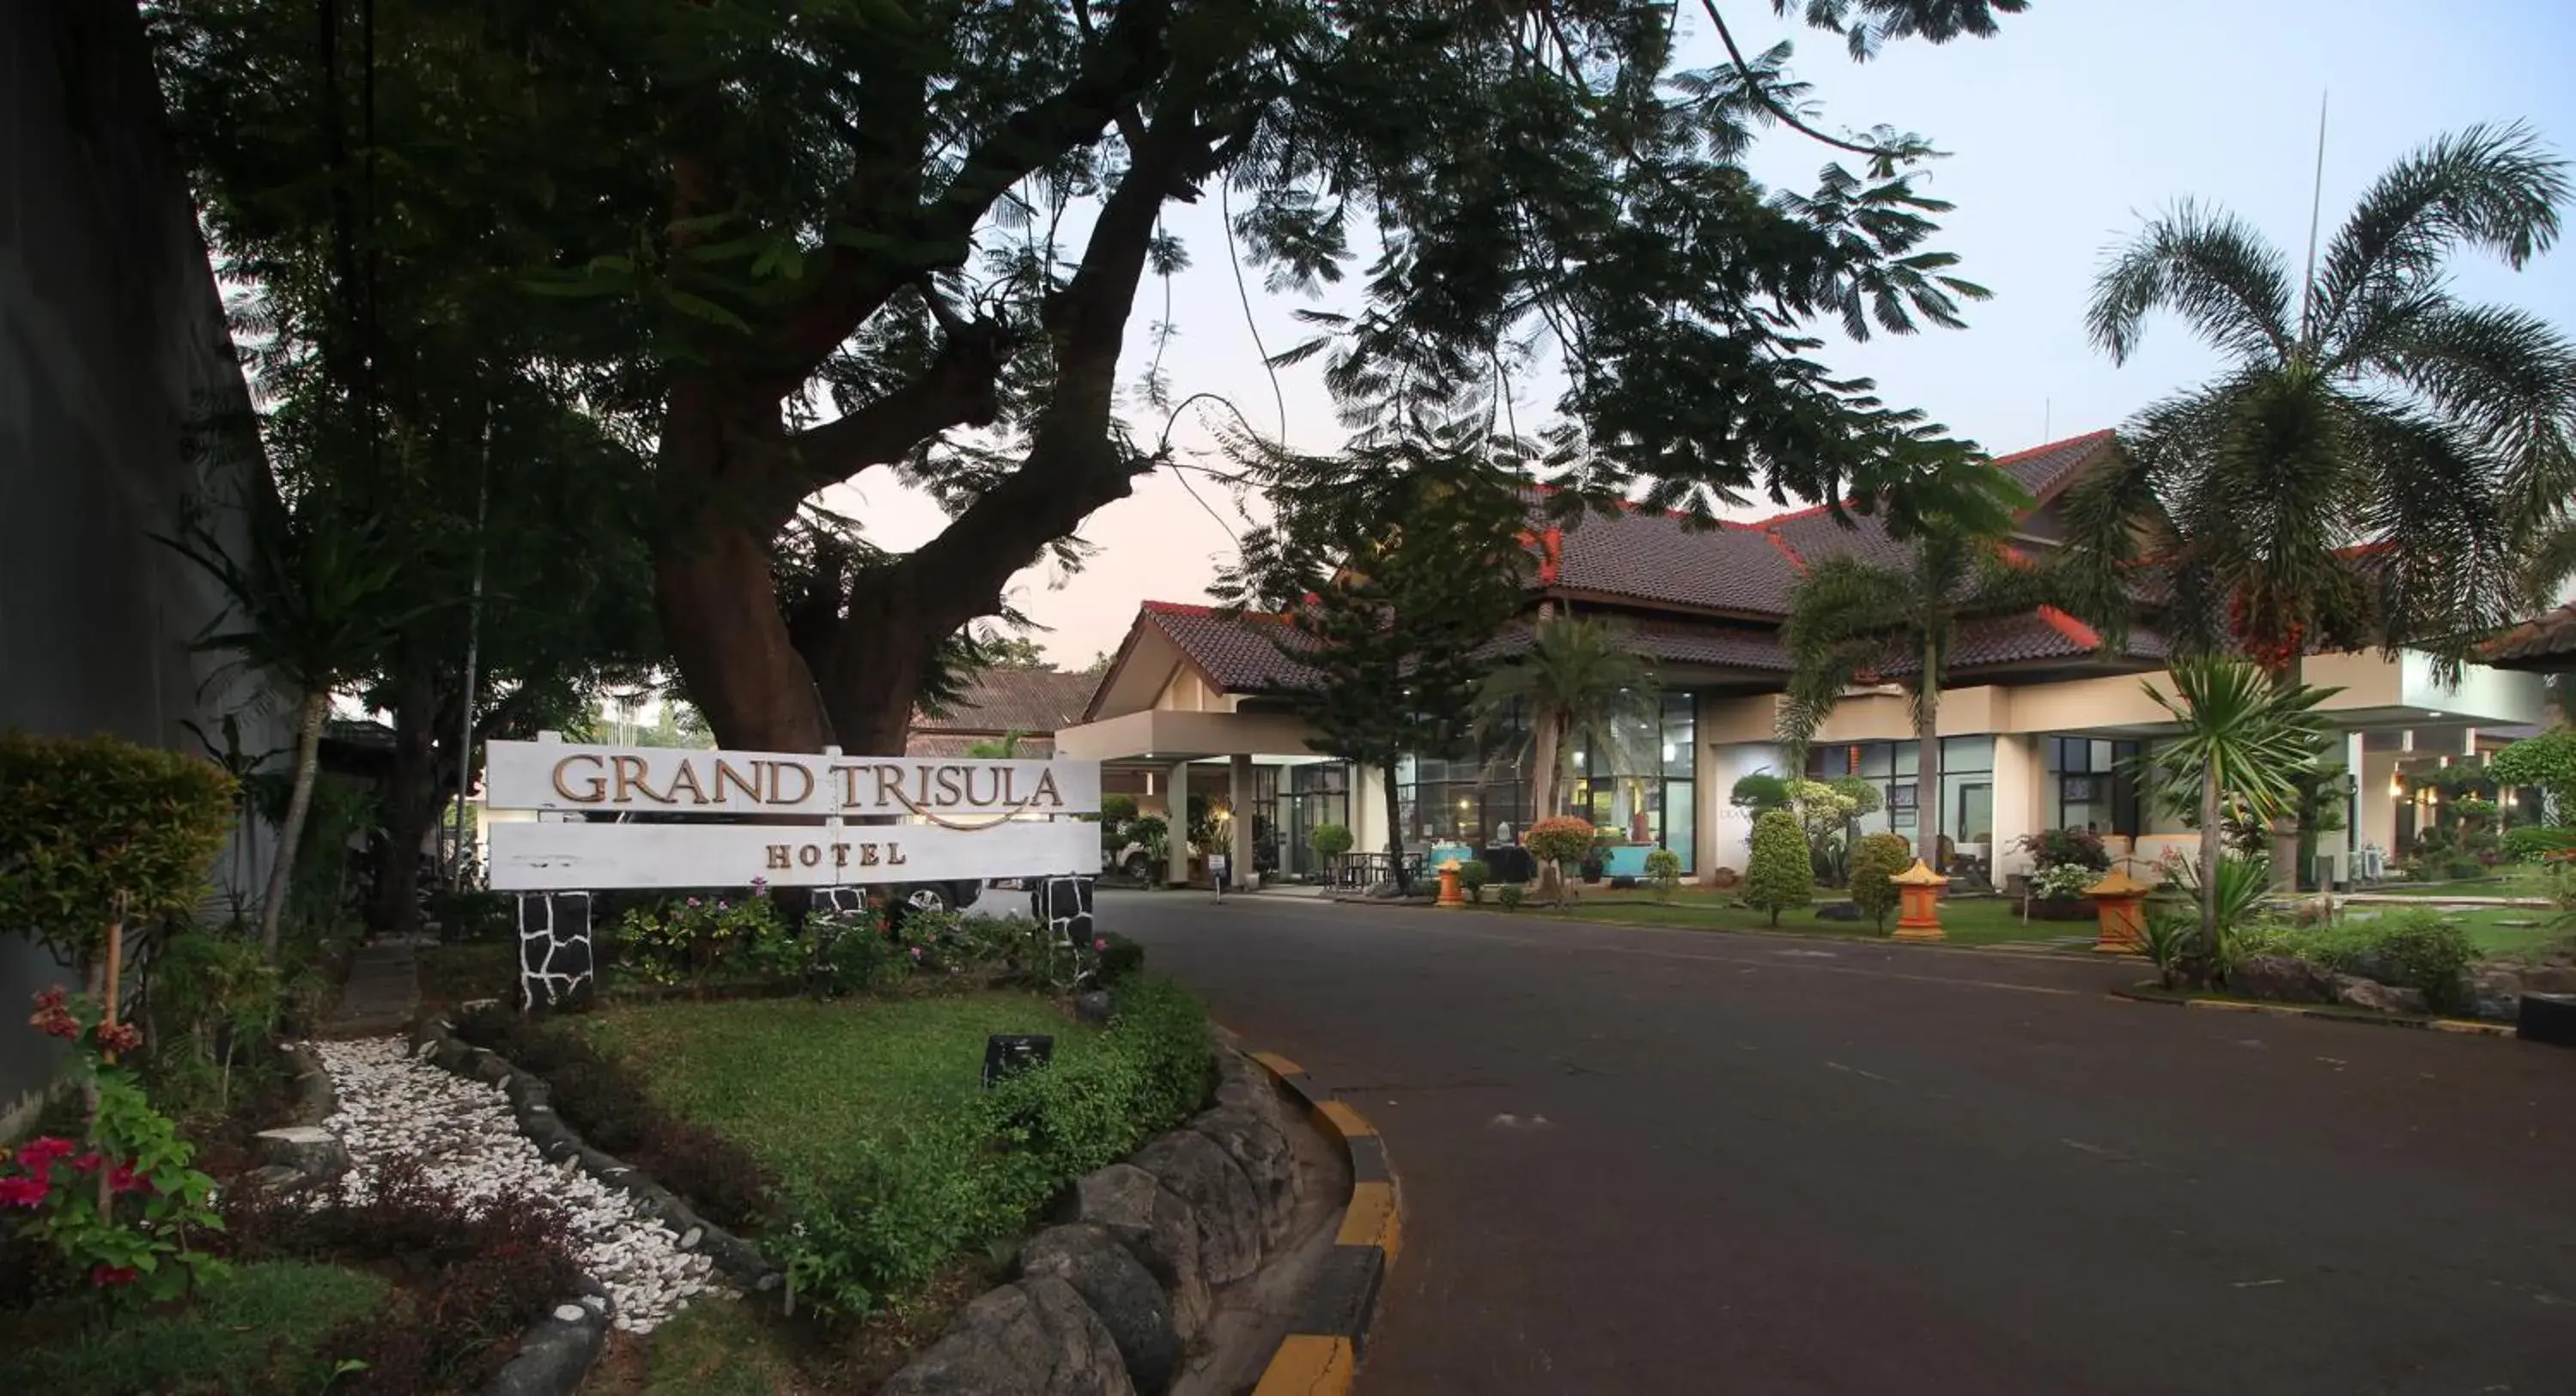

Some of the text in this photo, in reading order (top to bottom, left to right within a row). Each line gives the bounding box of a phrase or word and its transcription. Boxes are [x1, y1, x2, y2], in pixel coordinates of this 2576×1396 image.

[552, 754, 1065, 831] GRAND TRISULA
[766, 841, 907, 869] HOTEL
